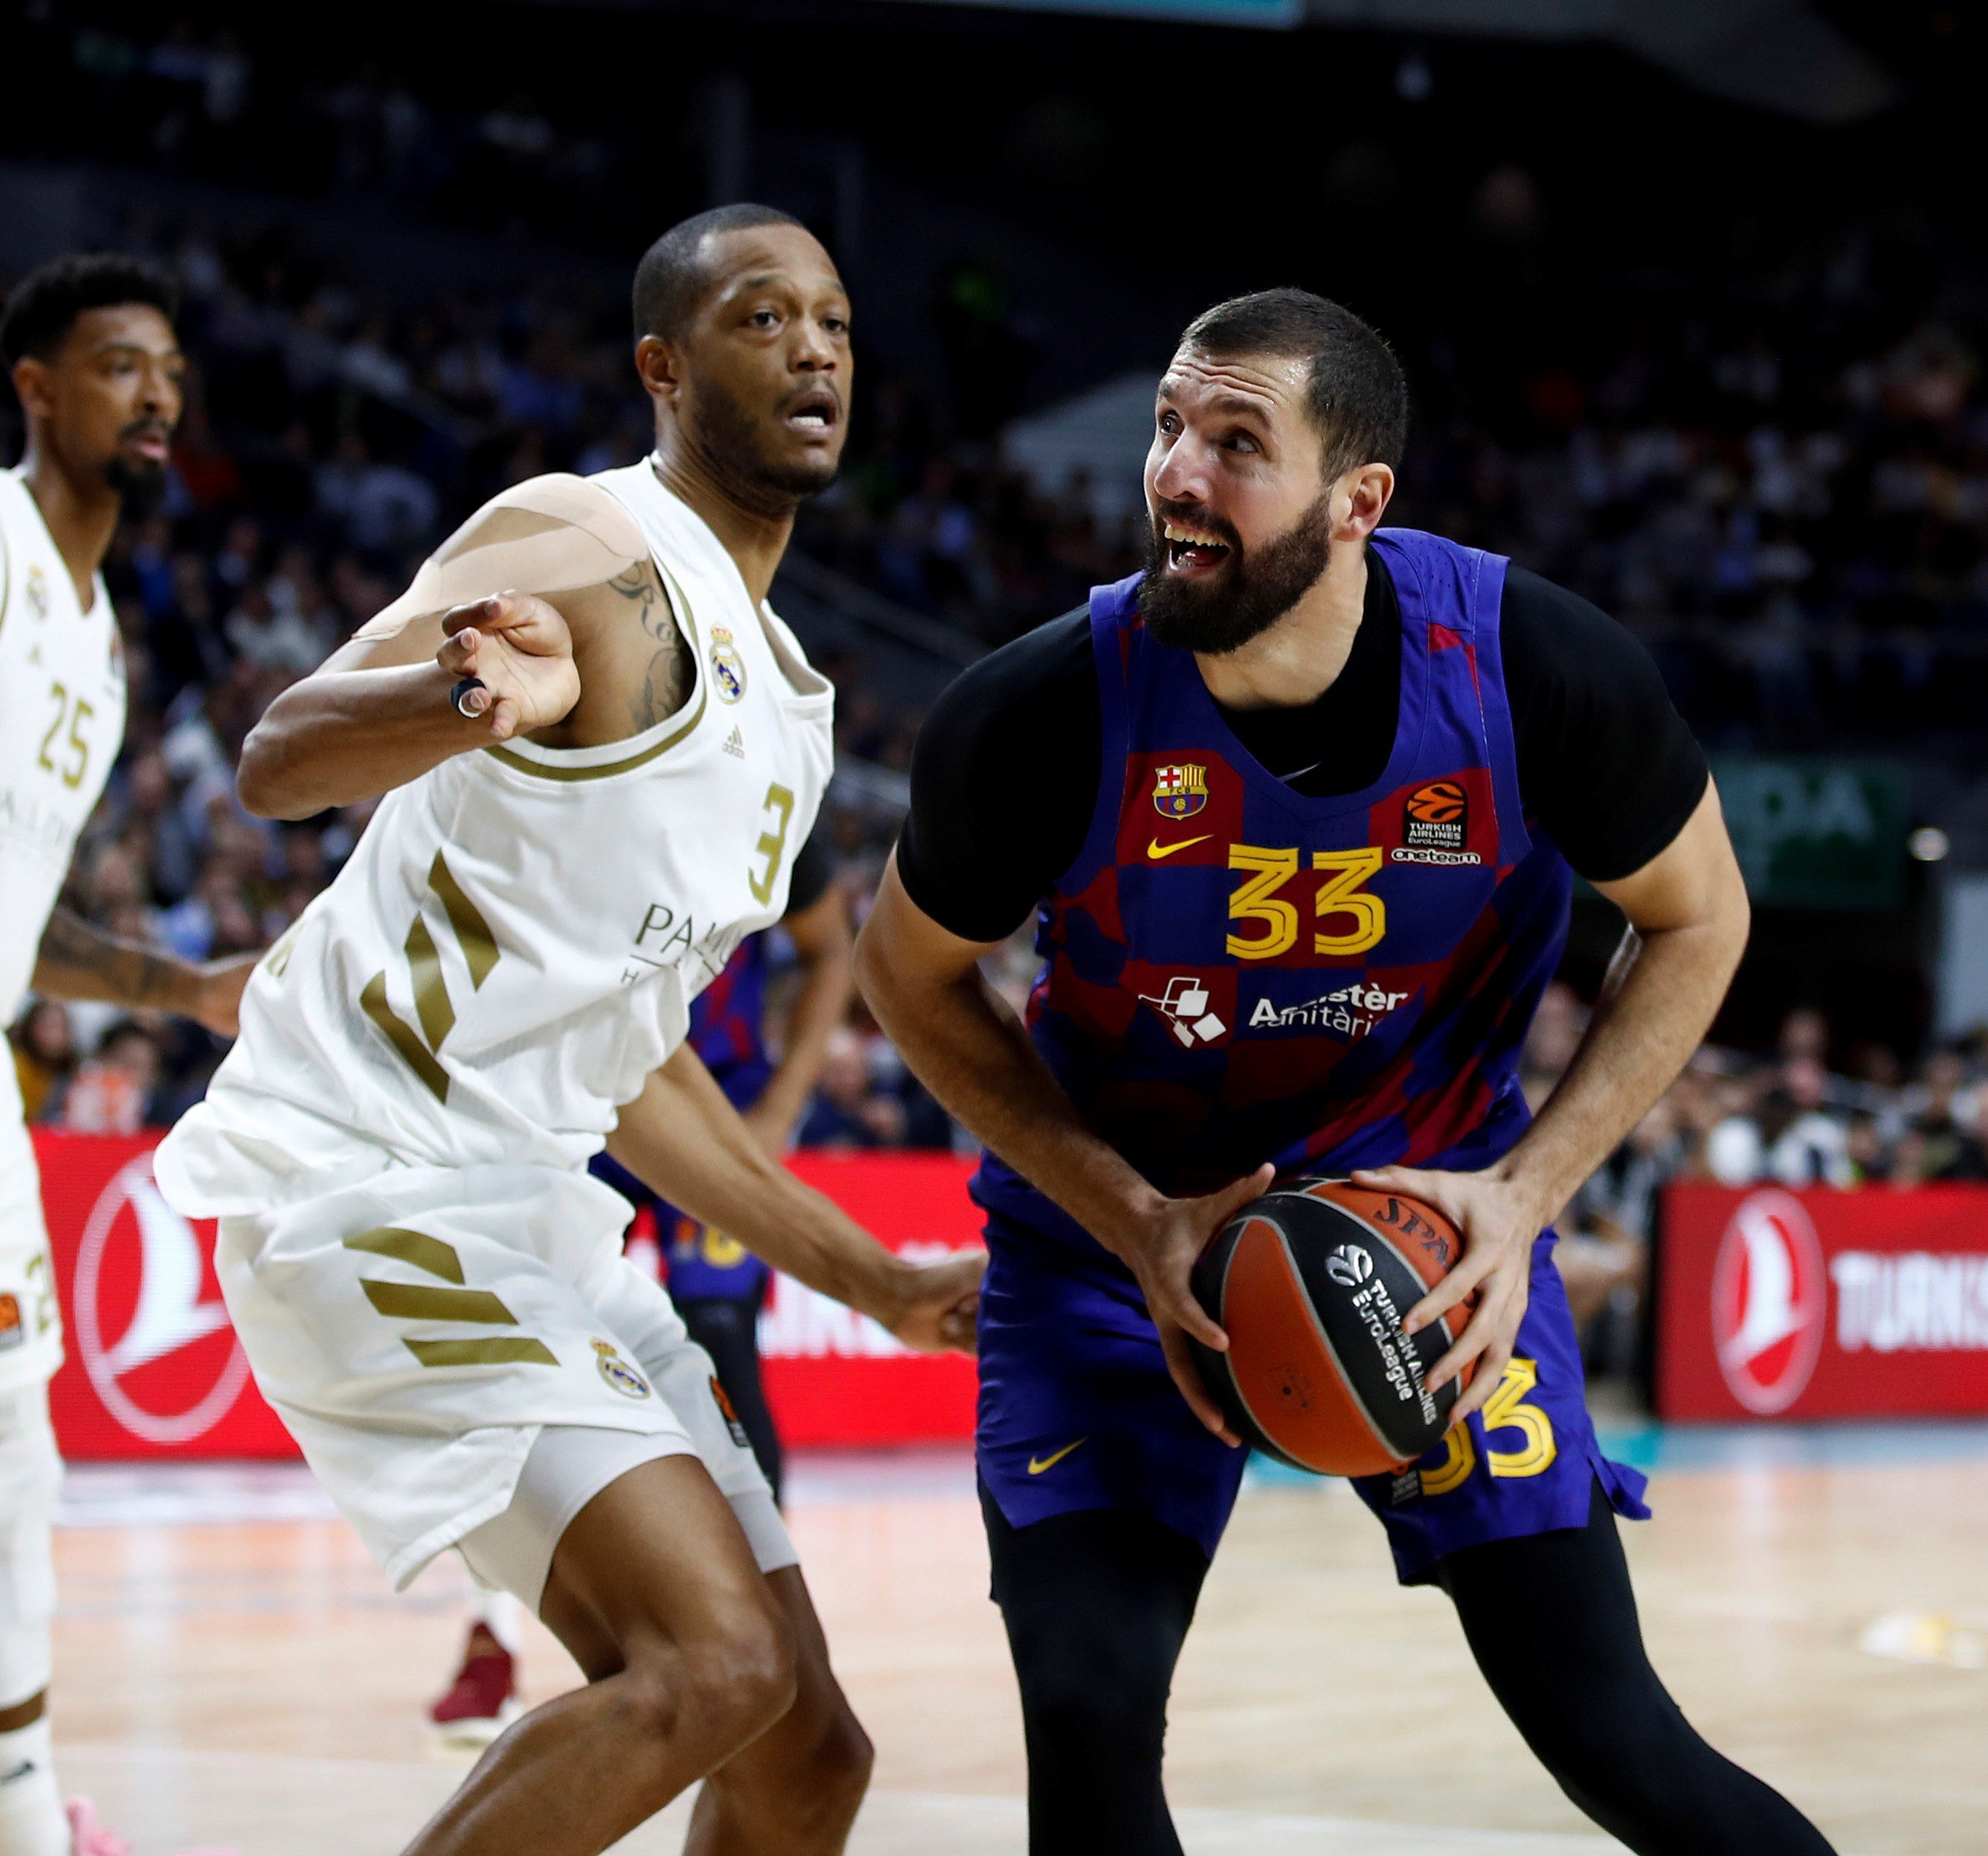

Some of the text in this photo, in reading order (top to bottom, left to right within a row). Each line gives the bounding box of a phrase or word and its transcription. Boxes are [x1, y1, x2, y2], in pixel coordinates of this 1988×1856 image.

[38, 682, 95, 790] 25
[748, 782, 794, 907] 3
[1408, 837, 1461, 848] EuroLeague
[1410, 822, 1461, 833] TURKISH
[1410, 830, 1461, 841] AIRLINES
[1226, 843, 1386, 960] 33
[1373, 1198, 1451, 1270] SPA
[1352, 1289, 1414, 1402] EuroLeague
